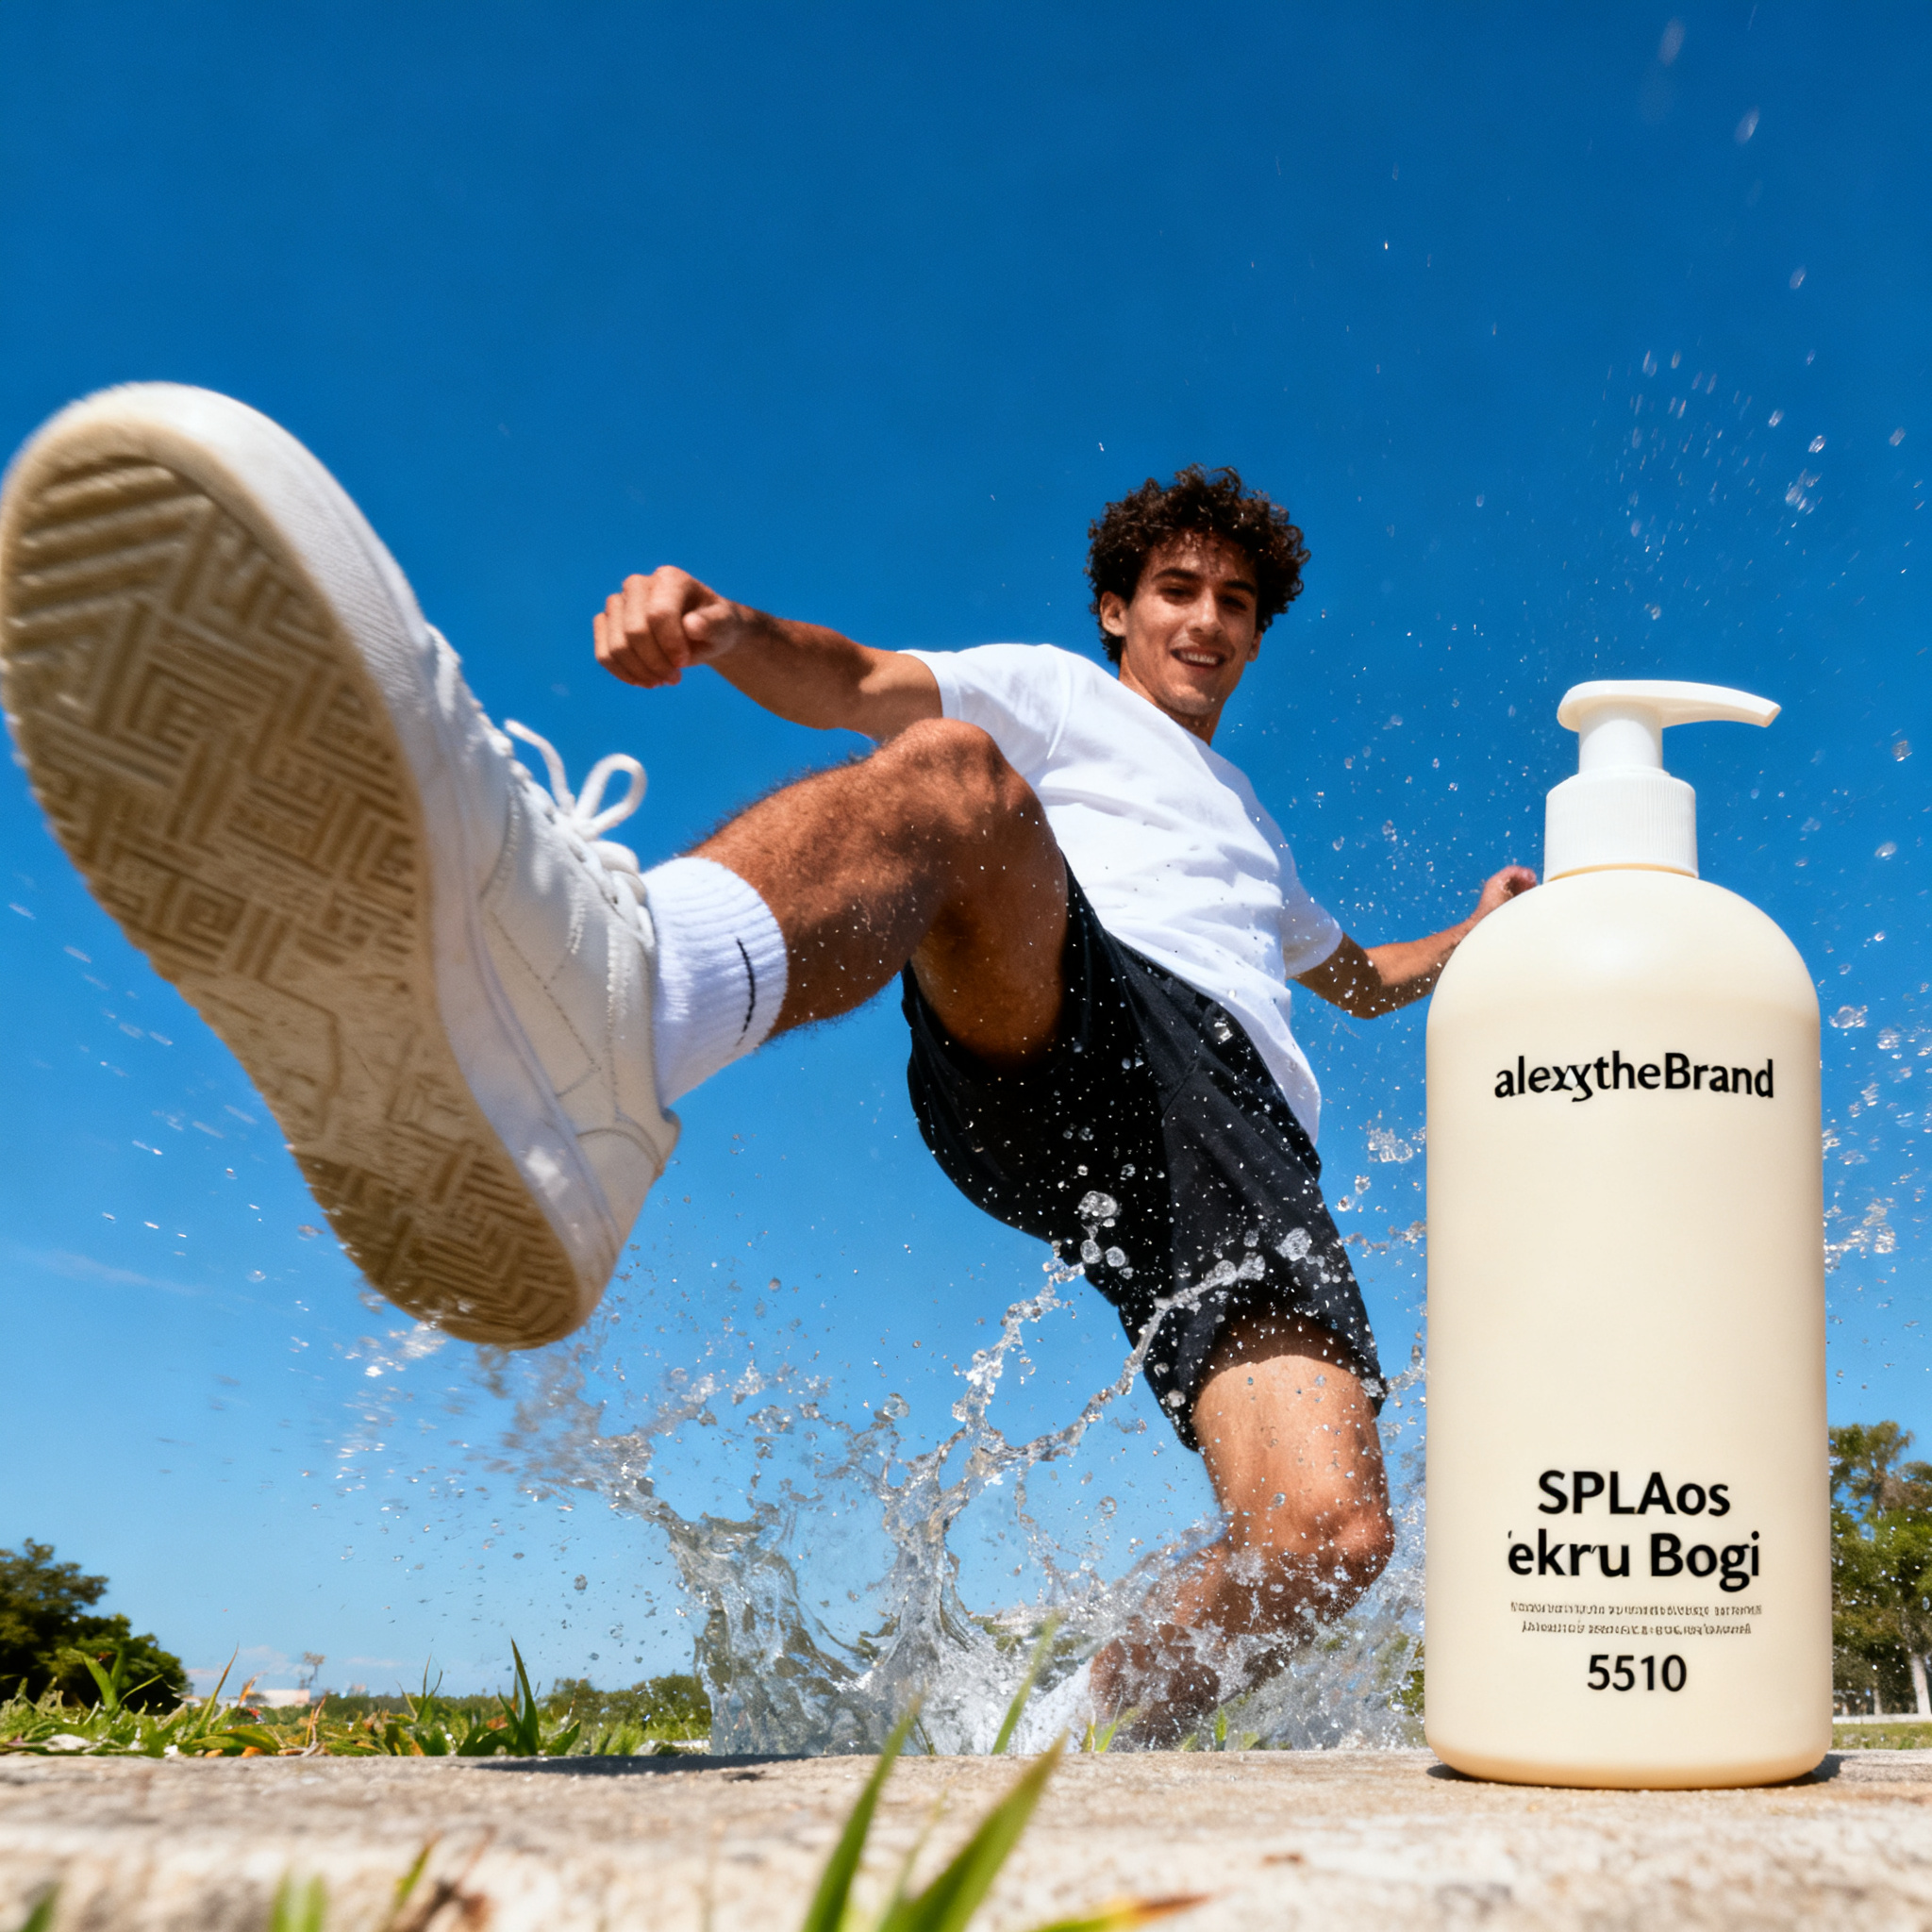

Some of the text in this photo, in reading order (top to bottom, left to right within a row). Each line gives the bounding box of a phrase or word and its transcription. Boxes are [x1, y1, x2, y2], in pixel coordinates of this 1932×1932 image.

[1537, 1469, 1731, 1517] SPLAos
[1650, 1530, 1760, 1593] Bogi
[1587, 1654, 1688, 1692] 5510
